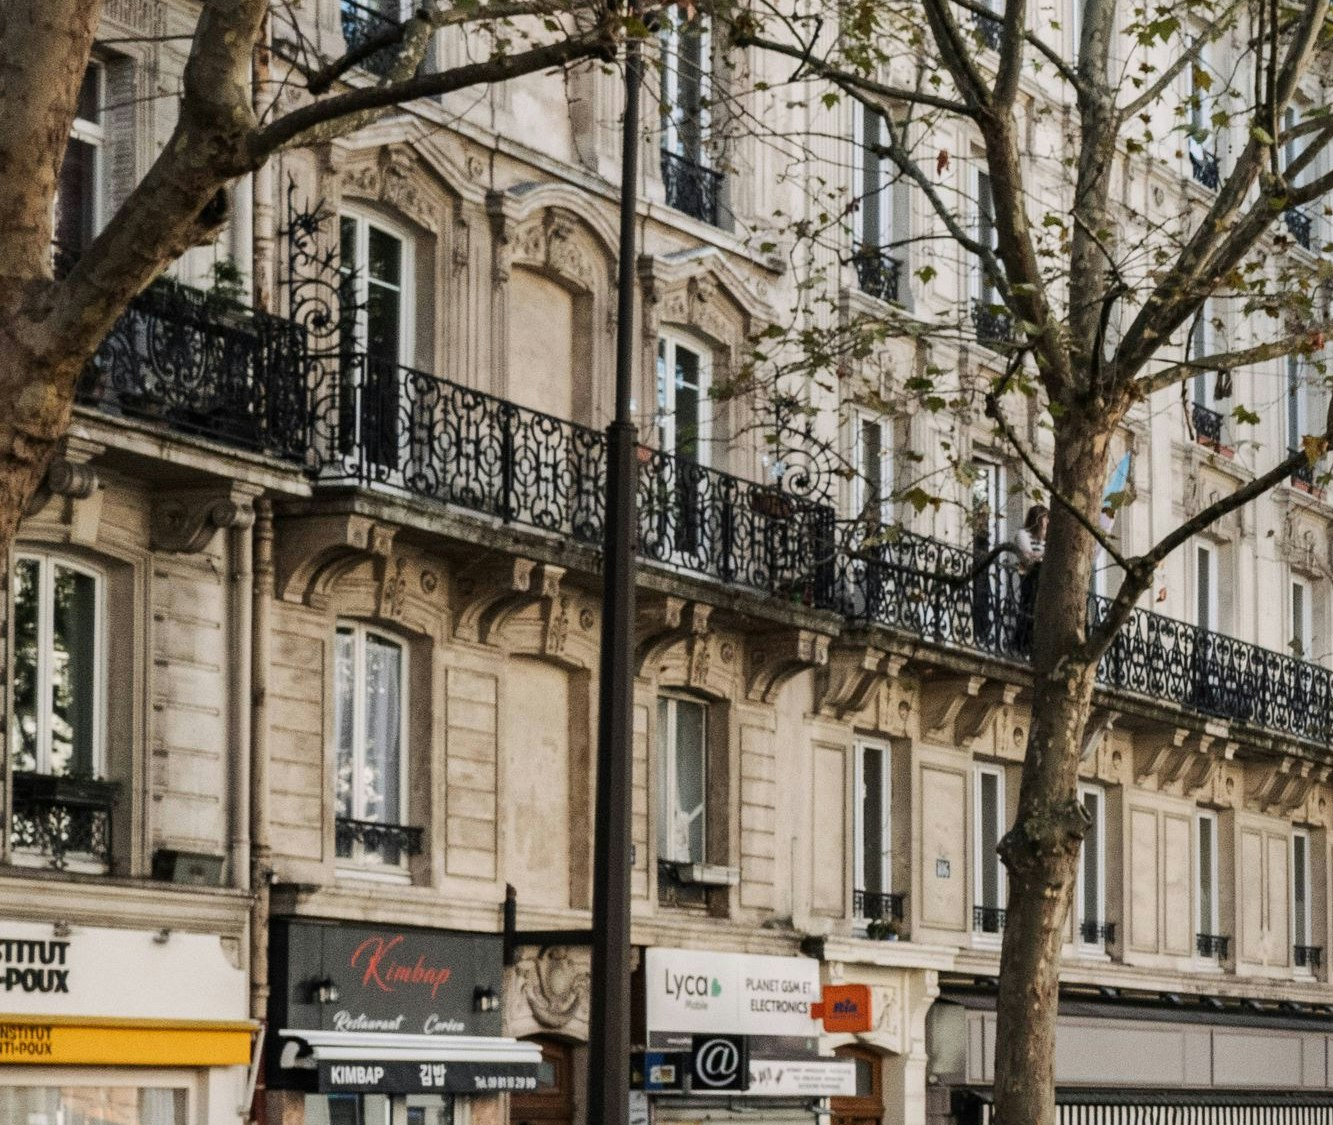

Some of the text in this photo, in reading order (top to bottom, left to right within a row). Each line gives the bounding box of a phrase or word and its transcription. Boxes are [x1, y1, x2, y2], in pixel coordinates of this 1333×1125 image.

[0, 939, 70, 964] TITUT
[351, 934, 452, 1000] Kimbap
[665, 968, 708, 1001] Lyca
[746, 977, 779, 993] PLANET
[781, 979, 801, 993] GSM
[751, 998, 808, 1013] ELECTRONICS
[333, 1010, 402, 1032] Restaurant
[331, 1066, 384, 1085] KIMBAP
